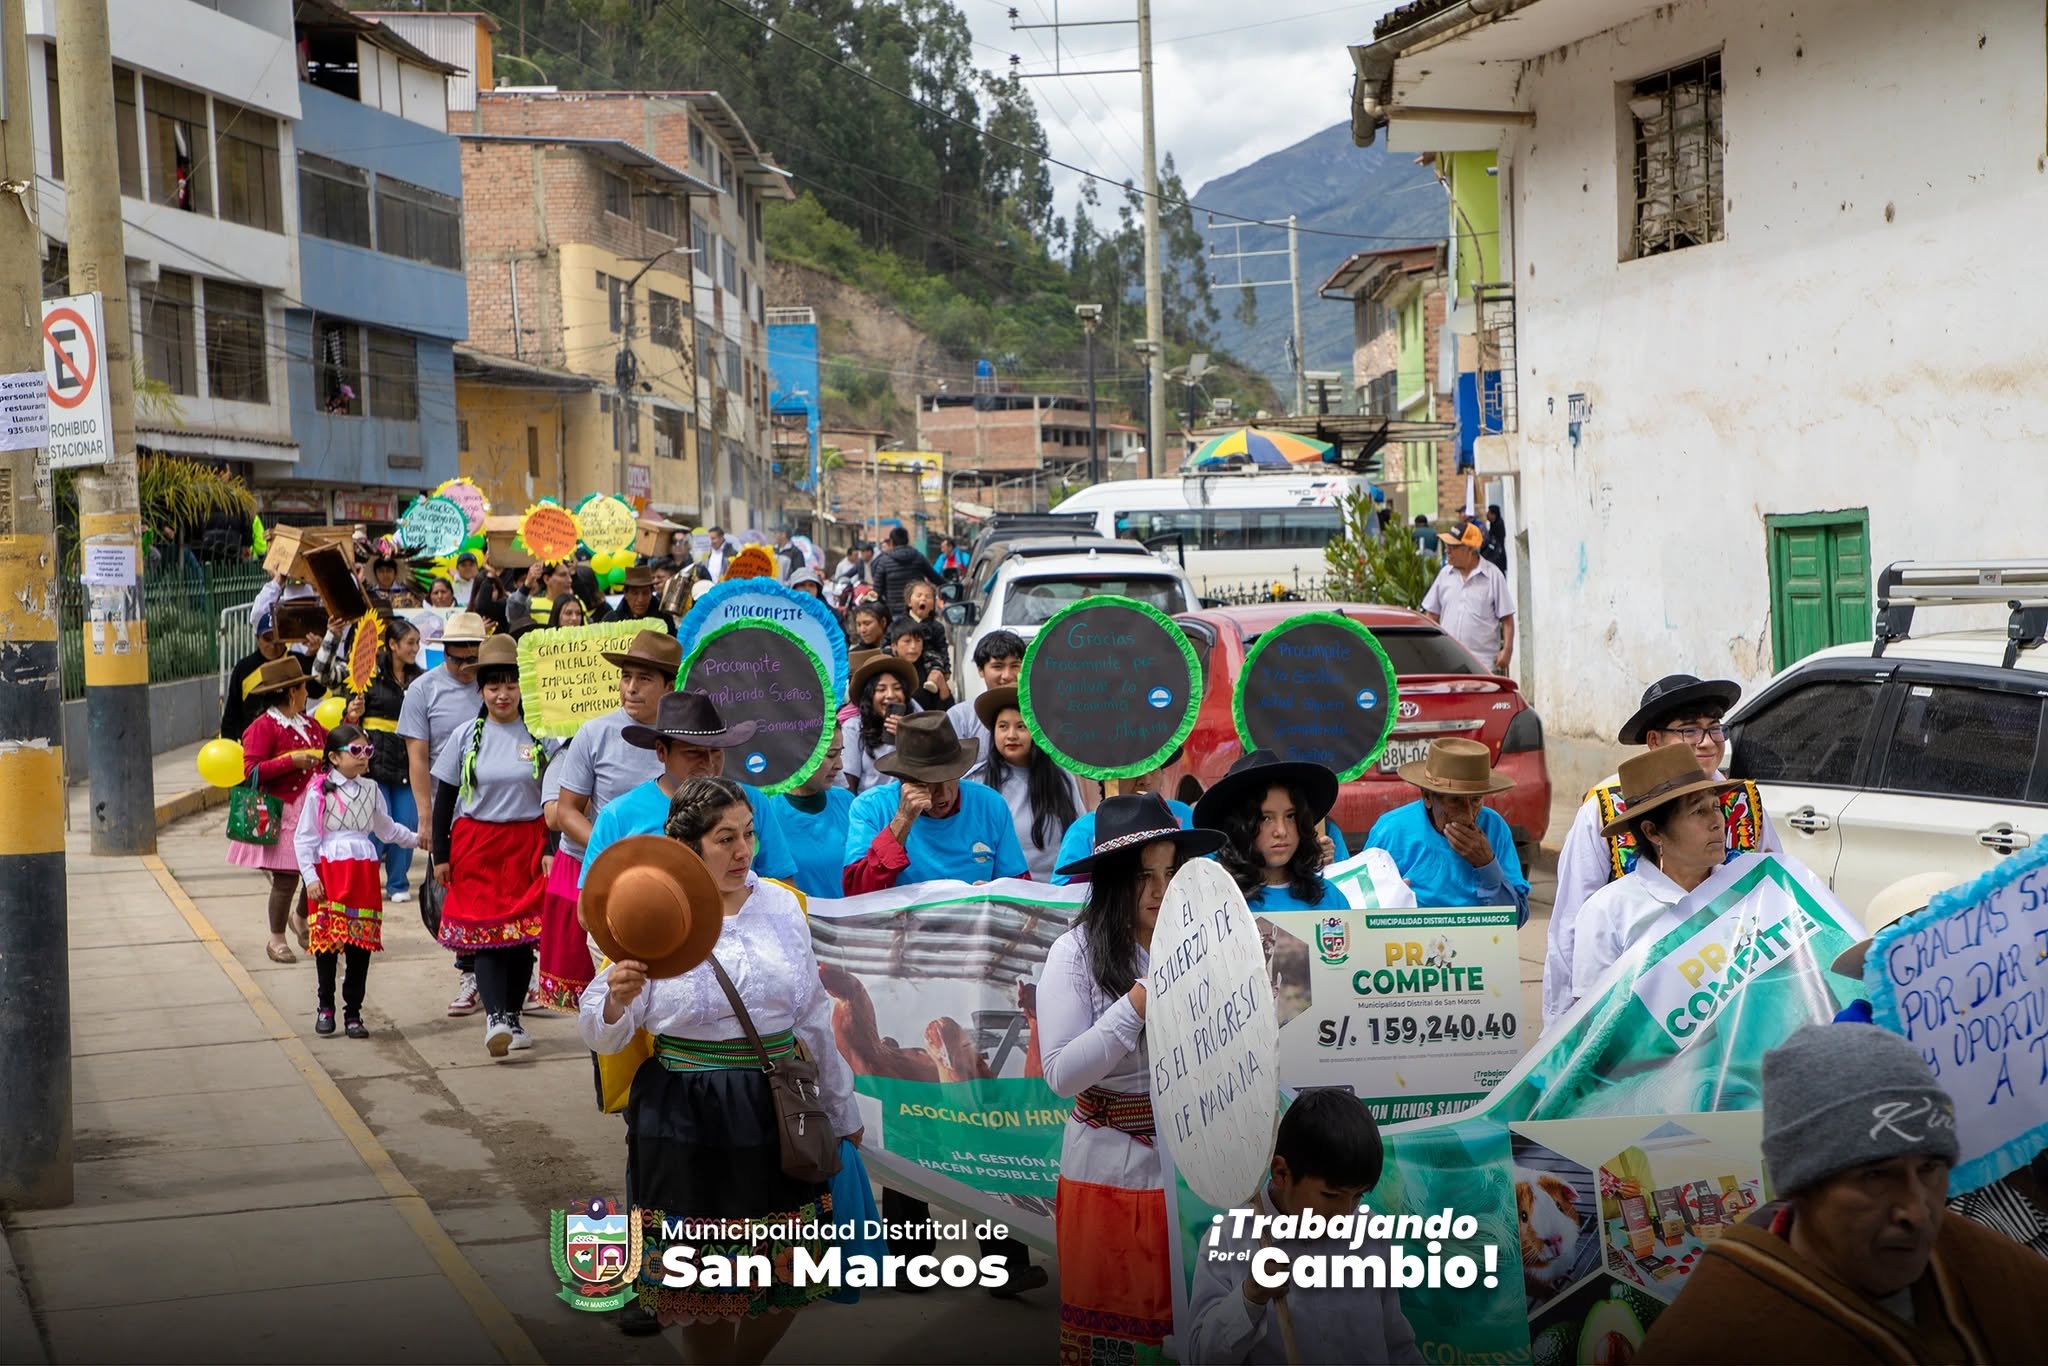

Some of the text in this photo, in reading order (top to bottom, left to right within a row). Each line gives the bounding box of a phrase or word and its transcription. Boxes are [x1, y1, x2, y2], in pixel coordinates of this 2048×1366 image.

[8, 426, 23, 435] 935
[50, 420, 96, 438] ROHIBIDO
[50, 440, 104, 459] STACIONAR
[724, 603, 803, 621] PROCOMPITE
[542, 671, 597, 688] IMPULSAR
[602, 669, 613, 681] EL
[704, 654, 781, 679] Procompite
[562, 689, 573, 699] DE
[582, 686, 598, 697] LOS
[769, 682, 812, 702] Sueños
[1183, 900, 1194, 928] EL
[1215, 901, 1232, 943] DE
[1370, 918, 1423, 926] MUNICIPALIDAD
[1424, 916, 1457, 924] DISTRITAL
[1468, 915, 1481, 923] SAN
[1482, 915, 1510, 923] MARCOS
[1889, 891, 2008, 986] GRACIAS
[1352, 966, 1485, 996] COMPITE
[1666, 909, 1817, 1038] COMPITE
[1188, 973, 1211, 1022] HOY
[1358, 1000, 1405, 1009] Municipalidad
[1407, 999, 1433, 1007] Distrital
[1444, 998, 1456, 1006] San
[1902, 976, 1961, 1041] POR
[1967, 944, 2028, 1008] DAR
[1155, 975, 1260, 1096] ES EL PROGRESO
[1319, 1013, 1516, 1049] S/. 159,240.40
[1987, 1052, 2014, 1105] A
[1174, 1050, 1263, 1143] DE MAÑANA
[900, 1104, 1019, 1128] ASOCIACION
[1393, 1101, 1434, 1118] HRNOS
[918, 1159, 973, 1175] HACEN
[976, 1166, 1041, 1182] POSIBLE
[979, 1153, 1046, 1168] GESTIÓN
